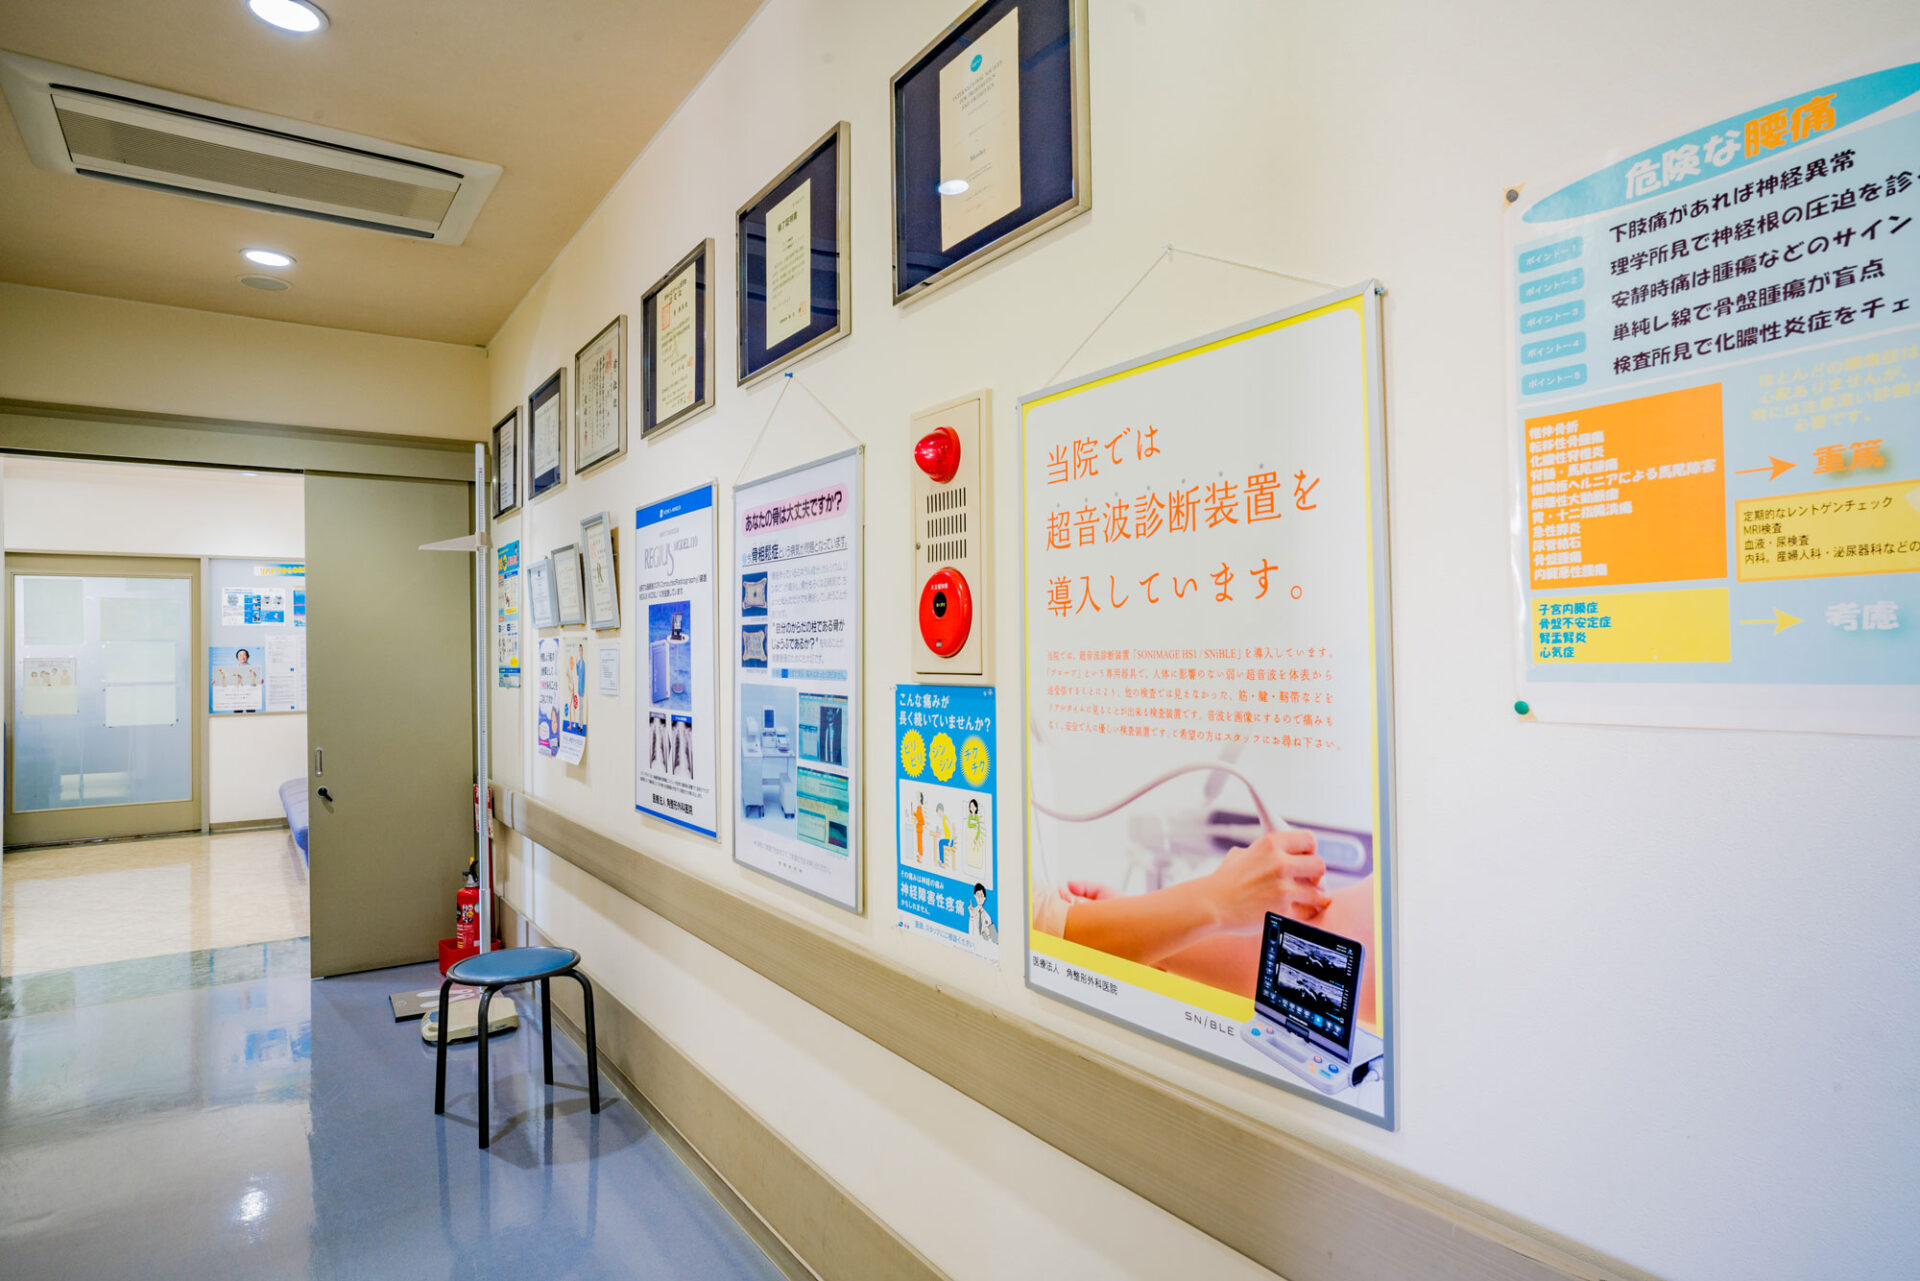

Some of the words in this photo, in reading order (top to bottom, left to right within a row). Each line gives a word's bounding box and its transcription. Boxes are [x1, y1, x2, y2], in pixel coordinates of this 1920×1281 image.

[1625, 92, 1839, 200] 危険な腰痛
[1609, 149, 1857, 244] 下肢痛があれば神経異常
[1610, 169, 1920, 276] 理学所見で神経根の圧迫を診
[1612, 213, 1914, 310] 安静時痛は腫瘍などのサイン
[1046, 424, 1161, 486] 当院では
[1812, 439, 1885, 475] 重篤
[745, 490, 843, 532] あなたの骨は大丈夫ですか?
[1046, 468, 1321, 552] 超音波診断装置を
[1743, 496, 1893, 523] 定期的なレントゲンチェック
[1743, 522, 1783, 536] MRI検査
[1744, 535, 1810, 551] 血液・尿検査
[1047, 558, 1303, 618] 導入しています。
[1538, 602, 1599, 616] 子宮内膜症
[1538, 616, 1613, 630] 骨盤不安定症
[1825, 600, 1900, 631] 考慮
[1539, 646, 1575, 659] 心気症
[899, 693, 950, 709] こんな痛みが
[898, 710, 991, 733] 長く続いていませんか?
[900, 882, 966, 917] 神経障害性疼痛
[1032, 955, 1060, 975] 医療法人
